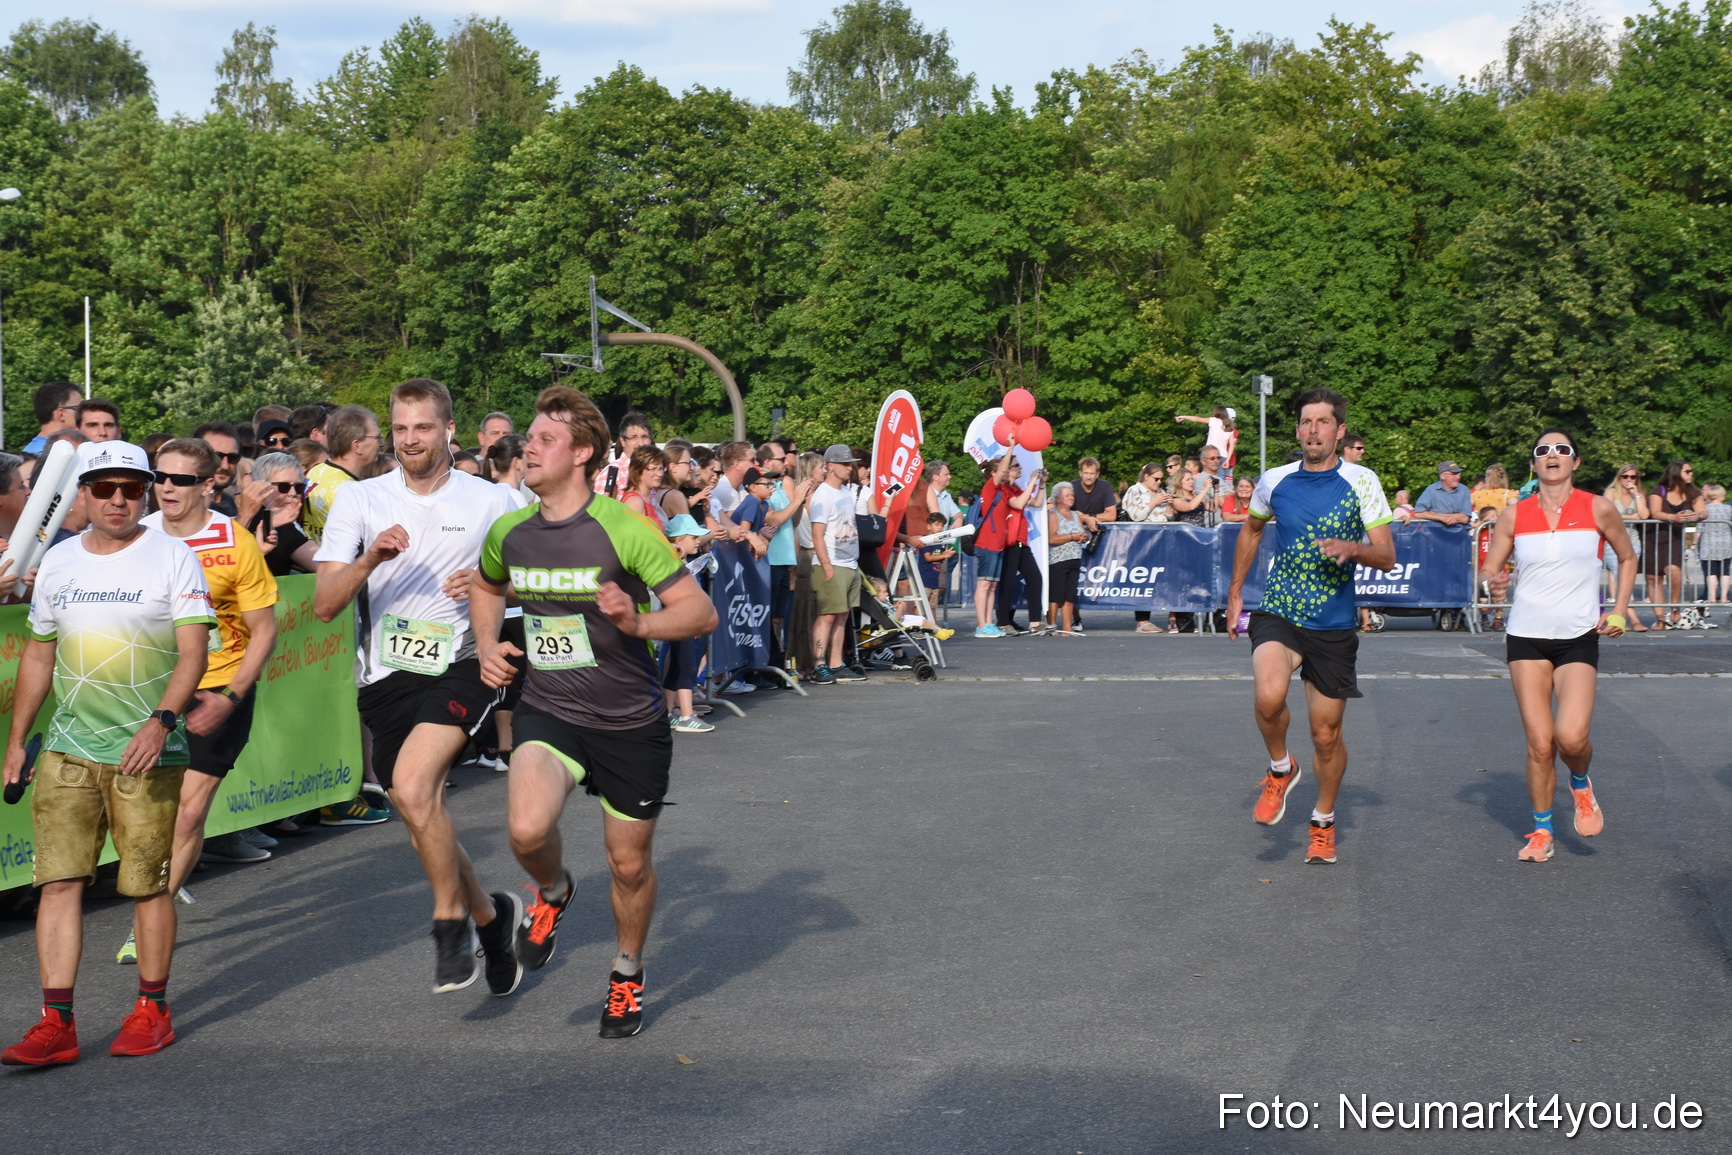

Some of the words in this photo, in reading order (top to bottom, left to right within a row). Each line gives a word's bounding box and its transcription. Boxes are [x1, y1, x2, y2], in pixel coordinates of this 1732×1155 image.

[904, 451, 921, 484] ener
[200, 553, 236, 568] ÖGL
[509, 568, 600, 591] BOCK
[1078, 560, 1165, 584] scher
[1354, 562, 1420, 581] cher
[72, 588, 143, 602] firmenlauf
[1077, 587, 1154, 598] TOMOBILE
[1355, 584, 1409, 595] MOBILE
[390, 635, 440, 660] 1724
[535, 636, 573, 655] 293
[540, 654, 554, 662] Max
[0, 834, 33, 880] pfalz
